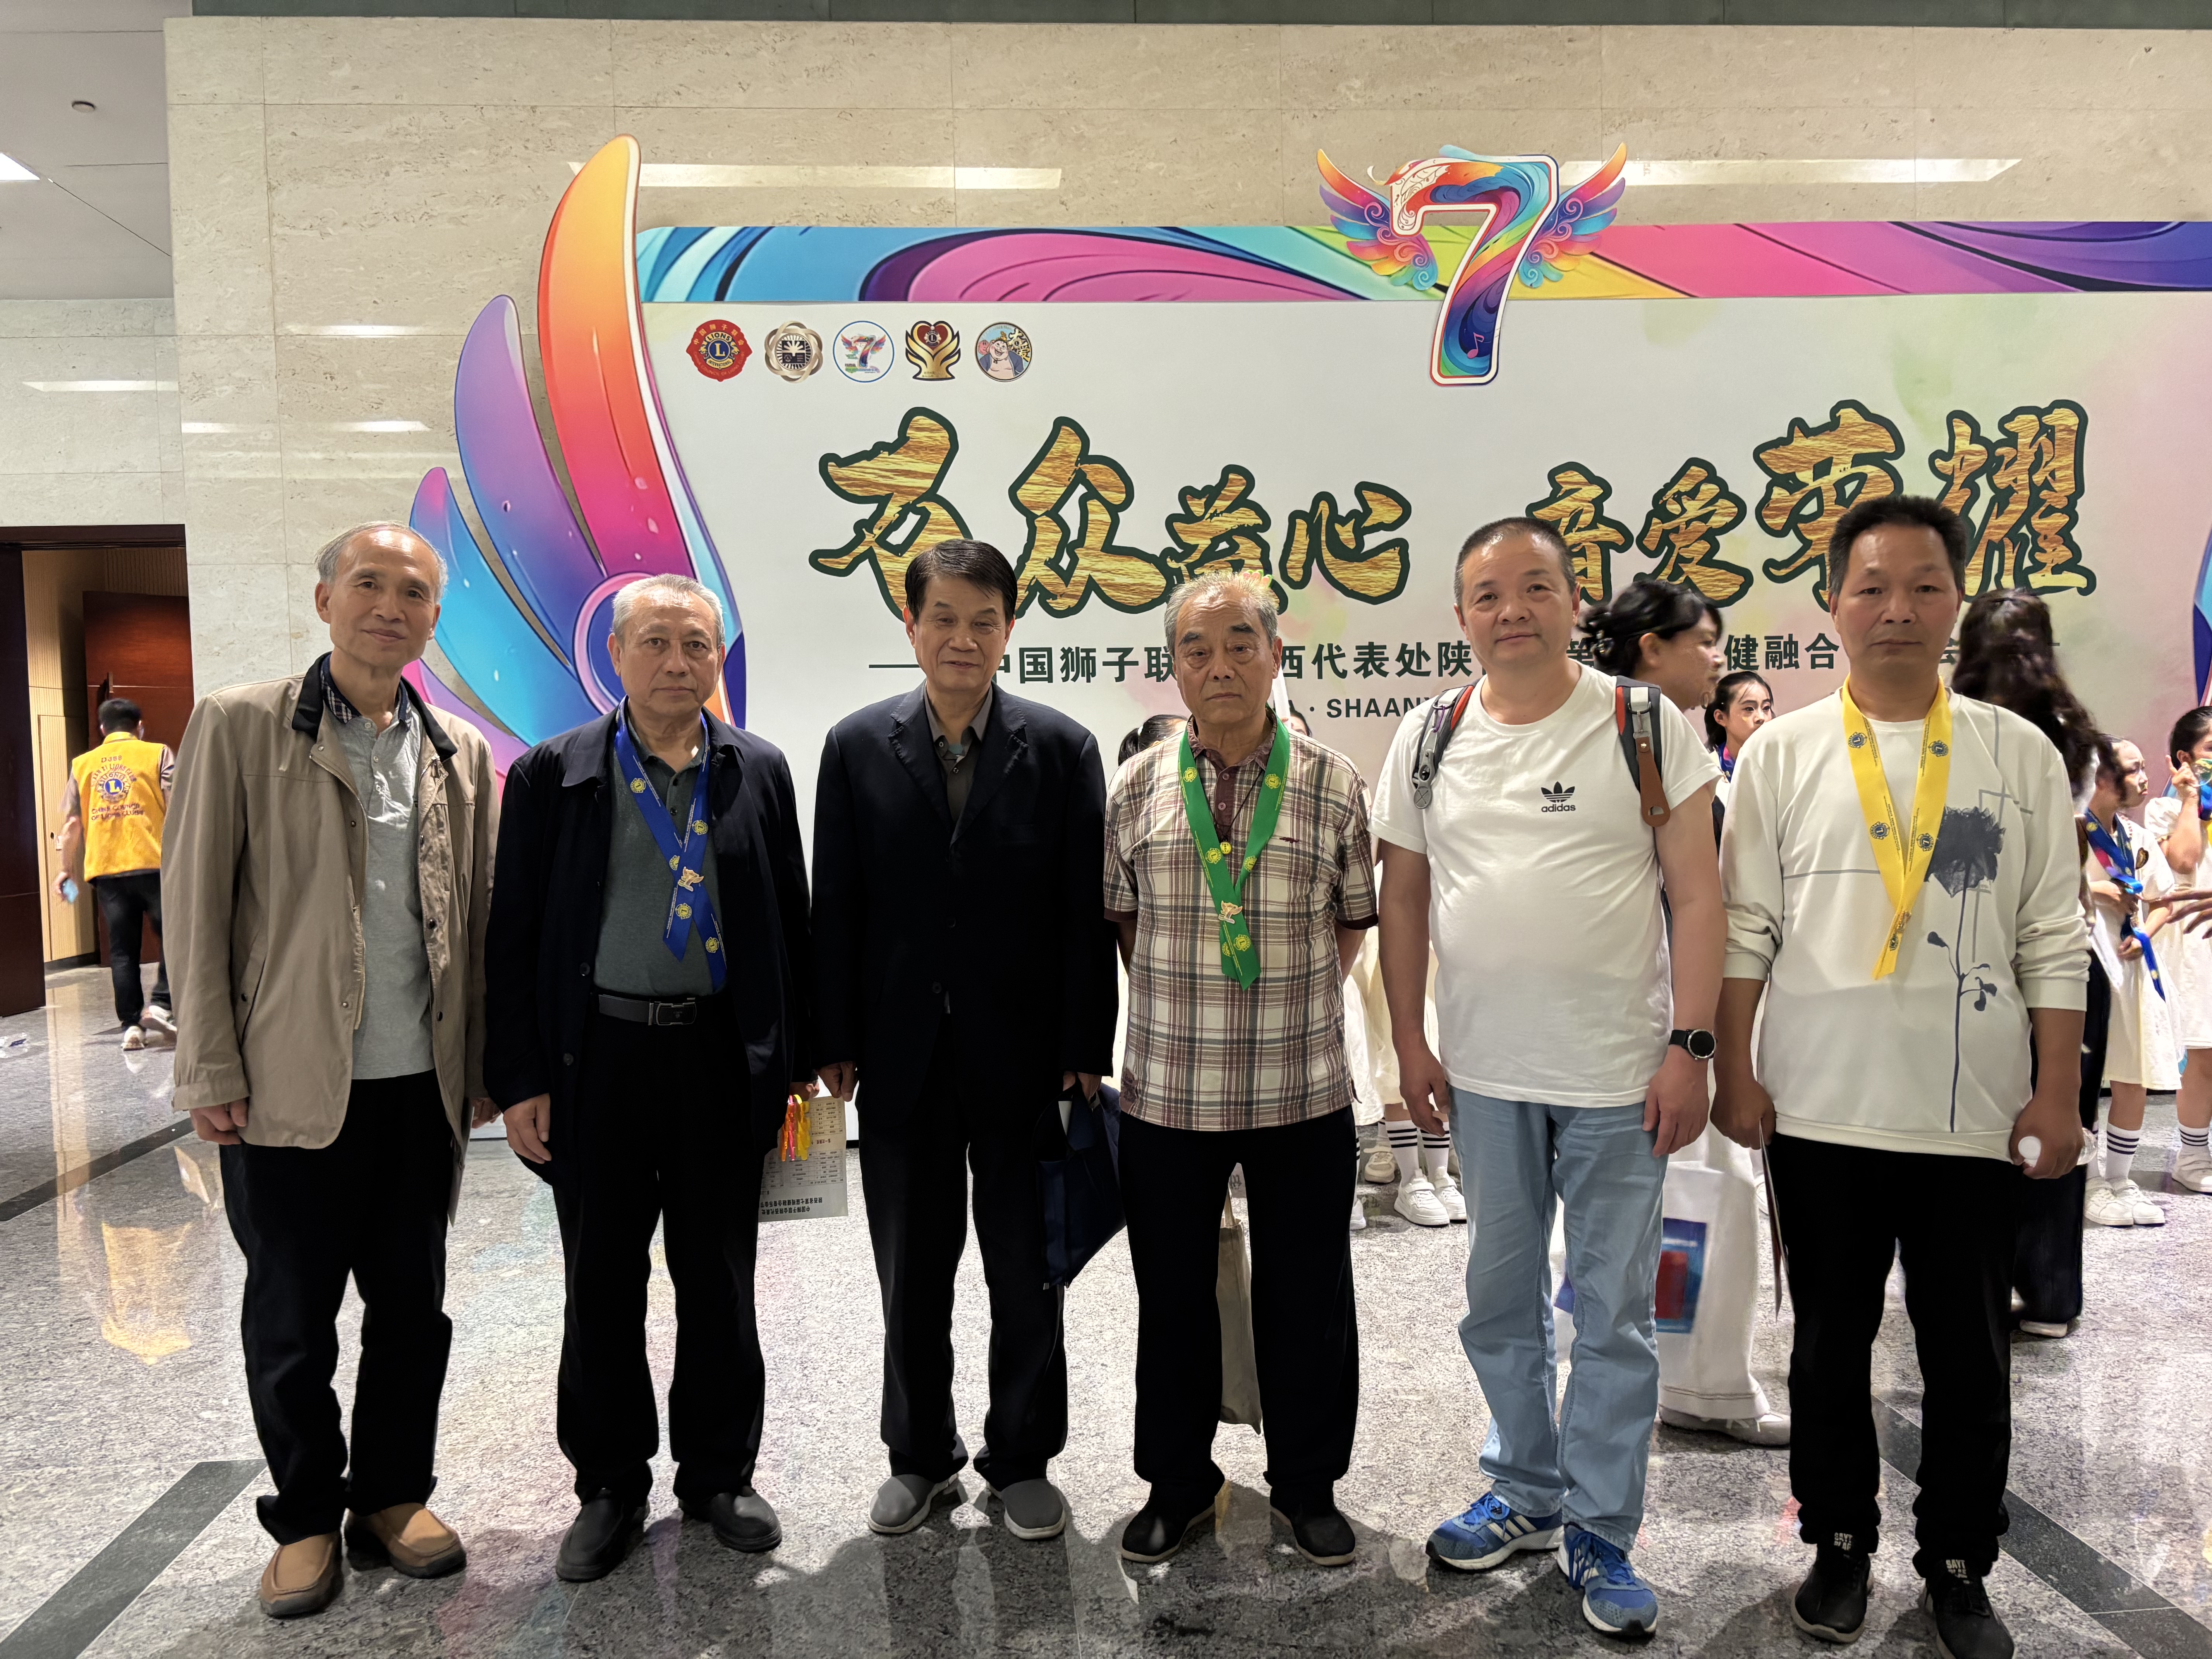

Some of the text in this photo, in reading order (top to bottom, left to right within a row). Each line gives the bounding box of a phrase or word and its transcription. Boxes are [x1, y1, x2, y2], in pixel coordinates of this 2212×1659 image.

[707, 332, 731, 342] LIONS
[715, 343, 726, 357] L
[1326, 697, 1432, 718] SHAAN
[108, 780, 120, 793] L
[1541, 804, 1576, 812] adidas
